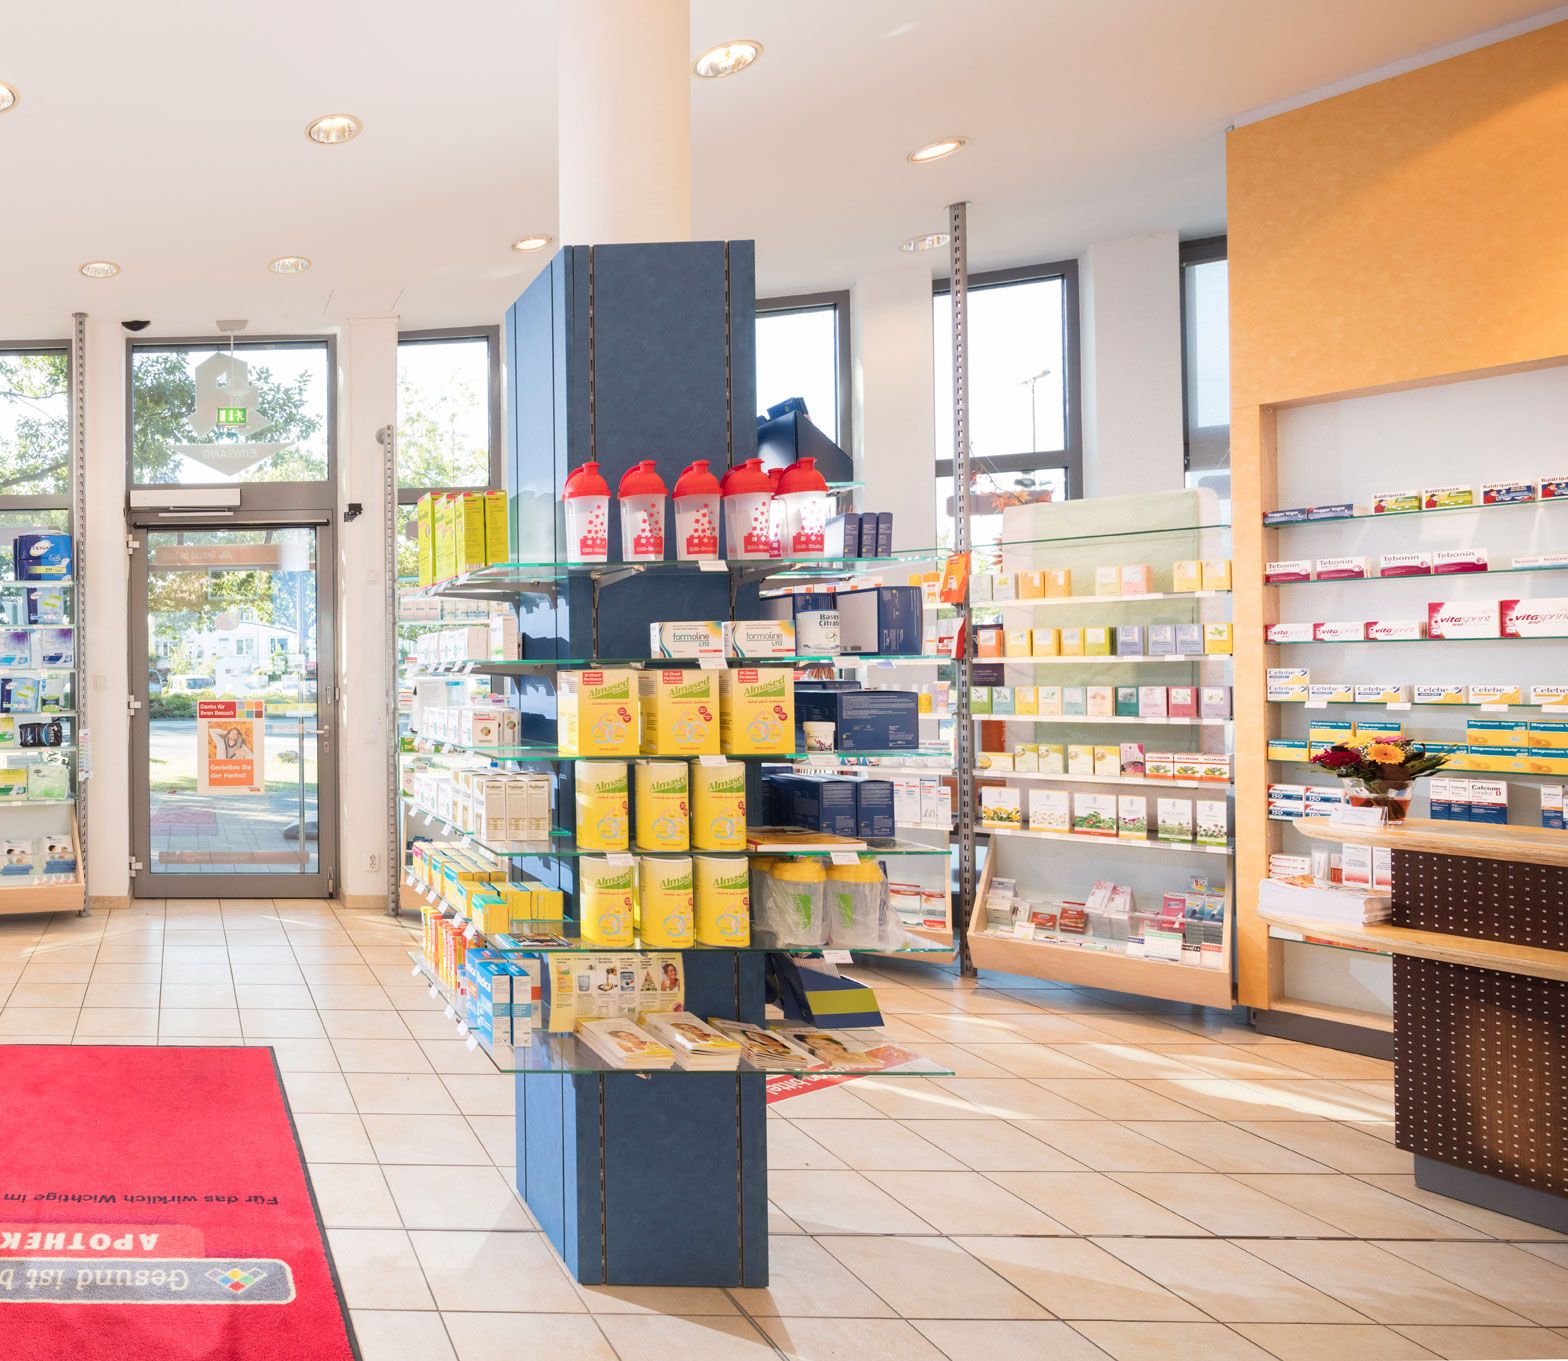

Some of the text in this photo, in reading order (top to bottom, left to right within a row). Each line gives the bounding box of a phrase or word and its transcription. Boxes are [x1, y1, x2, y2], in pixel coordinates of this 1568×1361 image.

[1383, 554, 1420, 562] Tebonin
[1437, 550, 1475, 559] Tebonin
[1269, 562, 1300, 570] Tebonin
[1440, 613, 1494, 626] vitasprint
[672, 632, 710, 641] formoline
[746, 632, 783, 641] formoline
[588, 677, 630, 699] Almased
[668, 676, 711, 698] Almased
[743, 674, 786, 697] Almased
[1357, 685, 1385, 693] Cetebe
[4, 1192, 32, 1203] im
[32, 1192, 119, 1206] Wichtige
[124, 1192, 196, 1205] wirklich
[201, 1194, 238, 1206] das
[243, 1194, 279, 1206] Für
[26, 1266, 64, 1291] ist
[75, 1268, 189, 1293] Gesund
